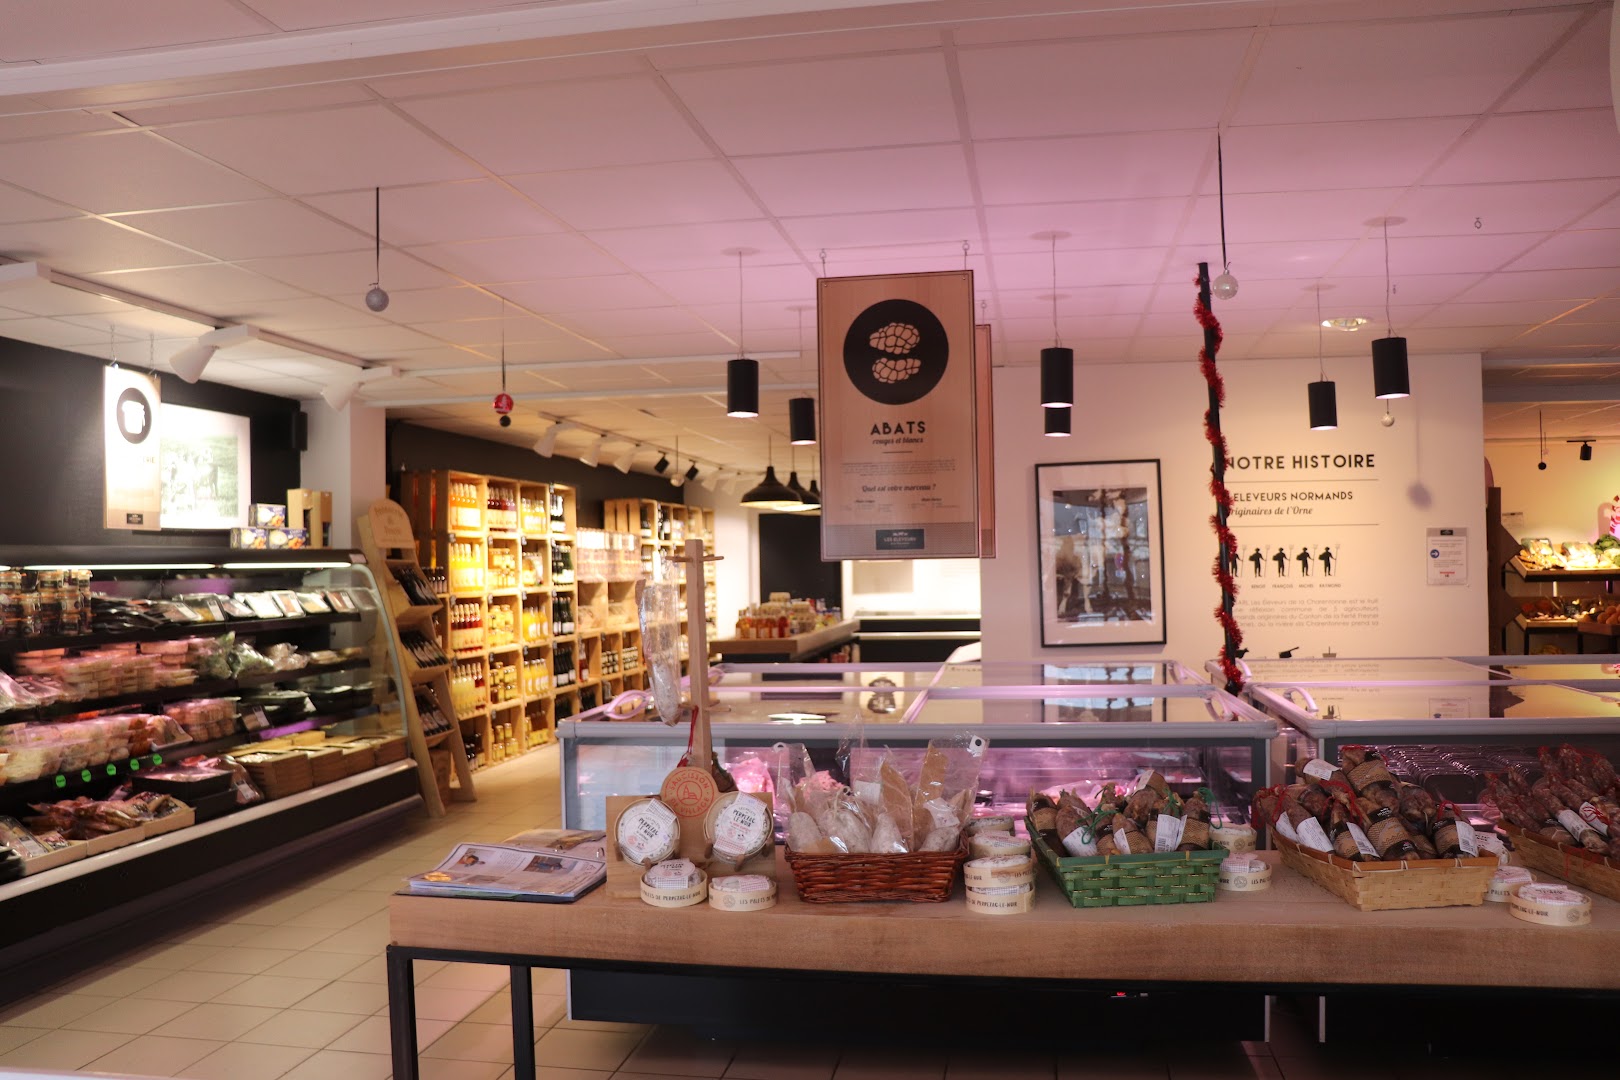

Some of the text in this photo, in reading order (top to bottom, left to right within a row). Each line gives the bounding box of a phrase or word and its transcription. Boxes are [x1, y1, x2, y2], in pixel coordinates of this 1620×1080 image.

[870, 421, 926, 436] ABATS
[1292, 454, 1375, 469] HISTOIRE
[862, 485, 876, 493] Quel
[1234, 491, 1353, 502] ELEVEURS NORMANDS
[1229, 506, 1313, 518] riginaires de l'Orne
[670, 772, 710, 790] SAUCISSON
[681, 798, 710, 814] VILLAGE
[733, 809, 756, 823] PERPEZAC
